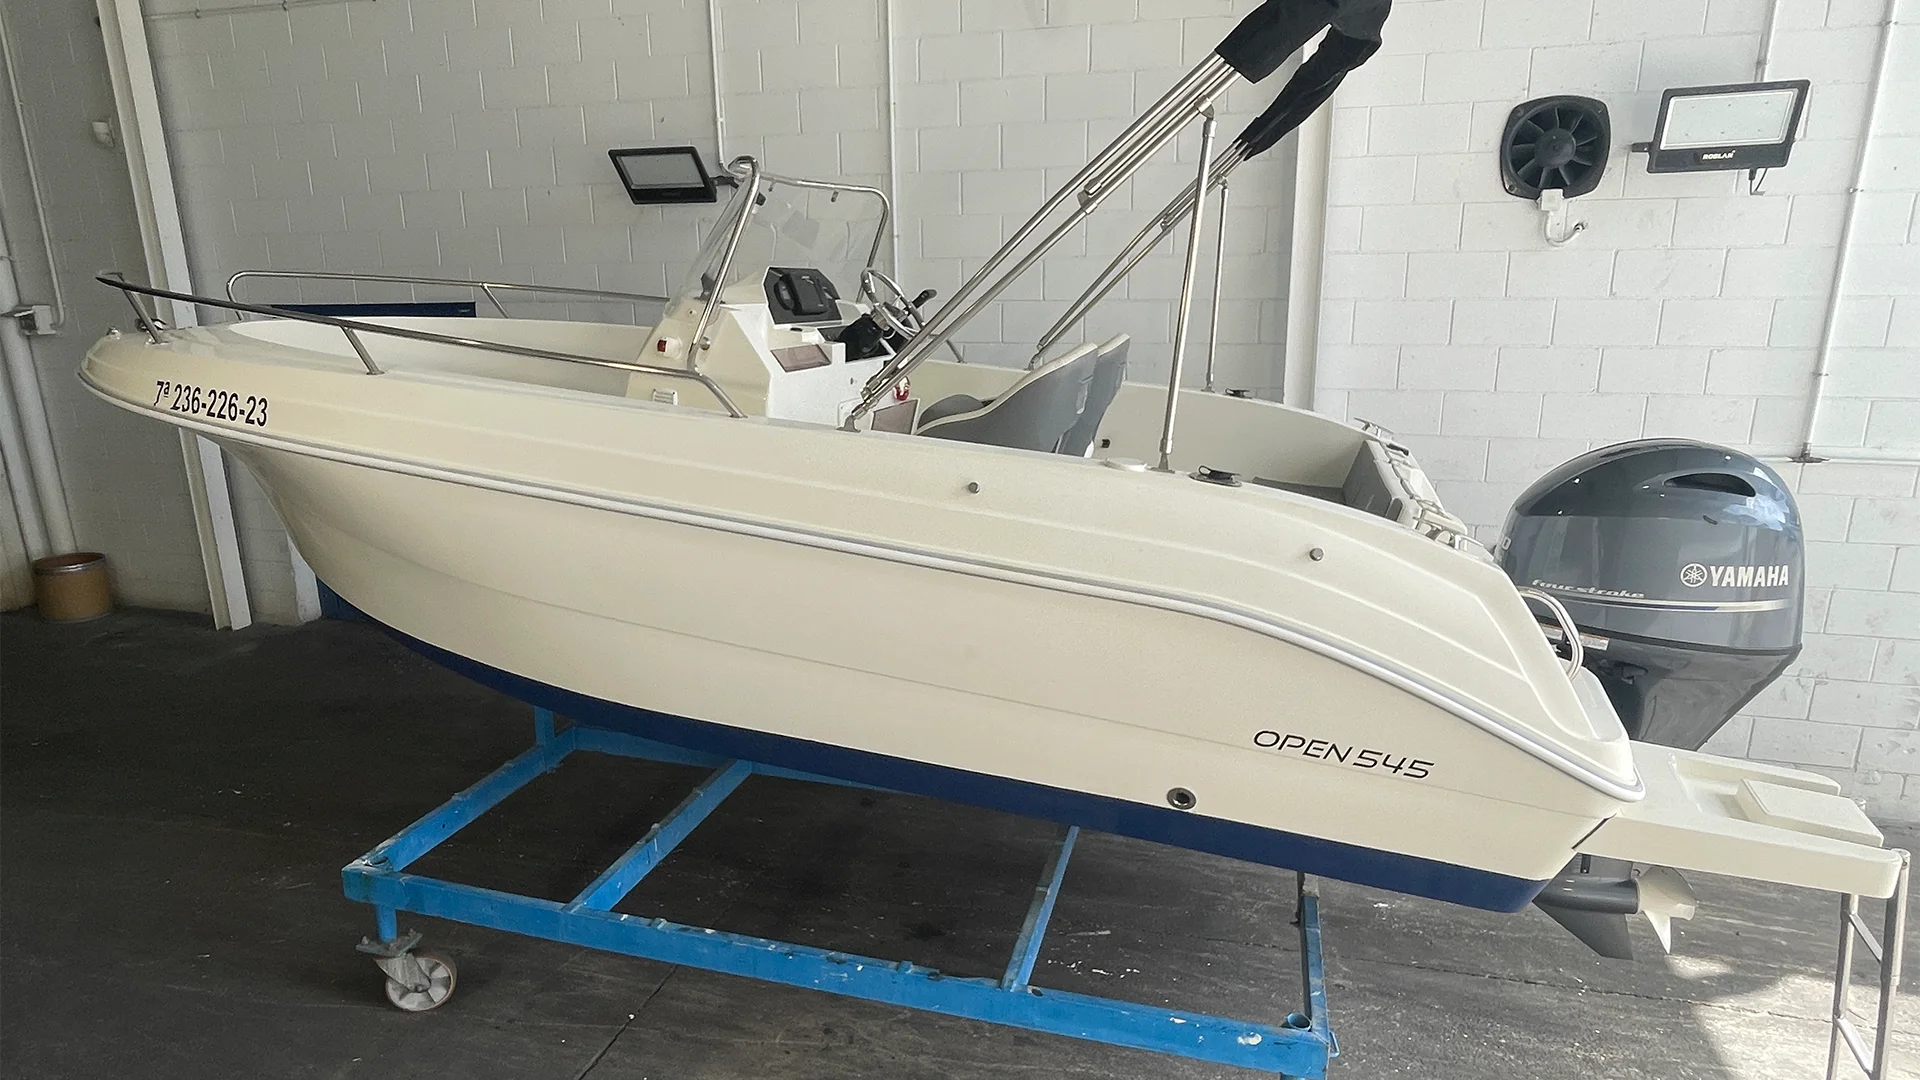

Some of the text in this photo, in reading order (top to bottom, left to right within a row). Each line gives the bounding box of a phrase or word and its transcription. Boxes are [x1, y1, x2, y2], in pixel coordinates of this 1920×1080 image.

[170, 384, 268, 427] 236-226-23
[1709, 565, 1789, 587] YAMAHA
[1253, 730, 1435, 779] OPEN 545
